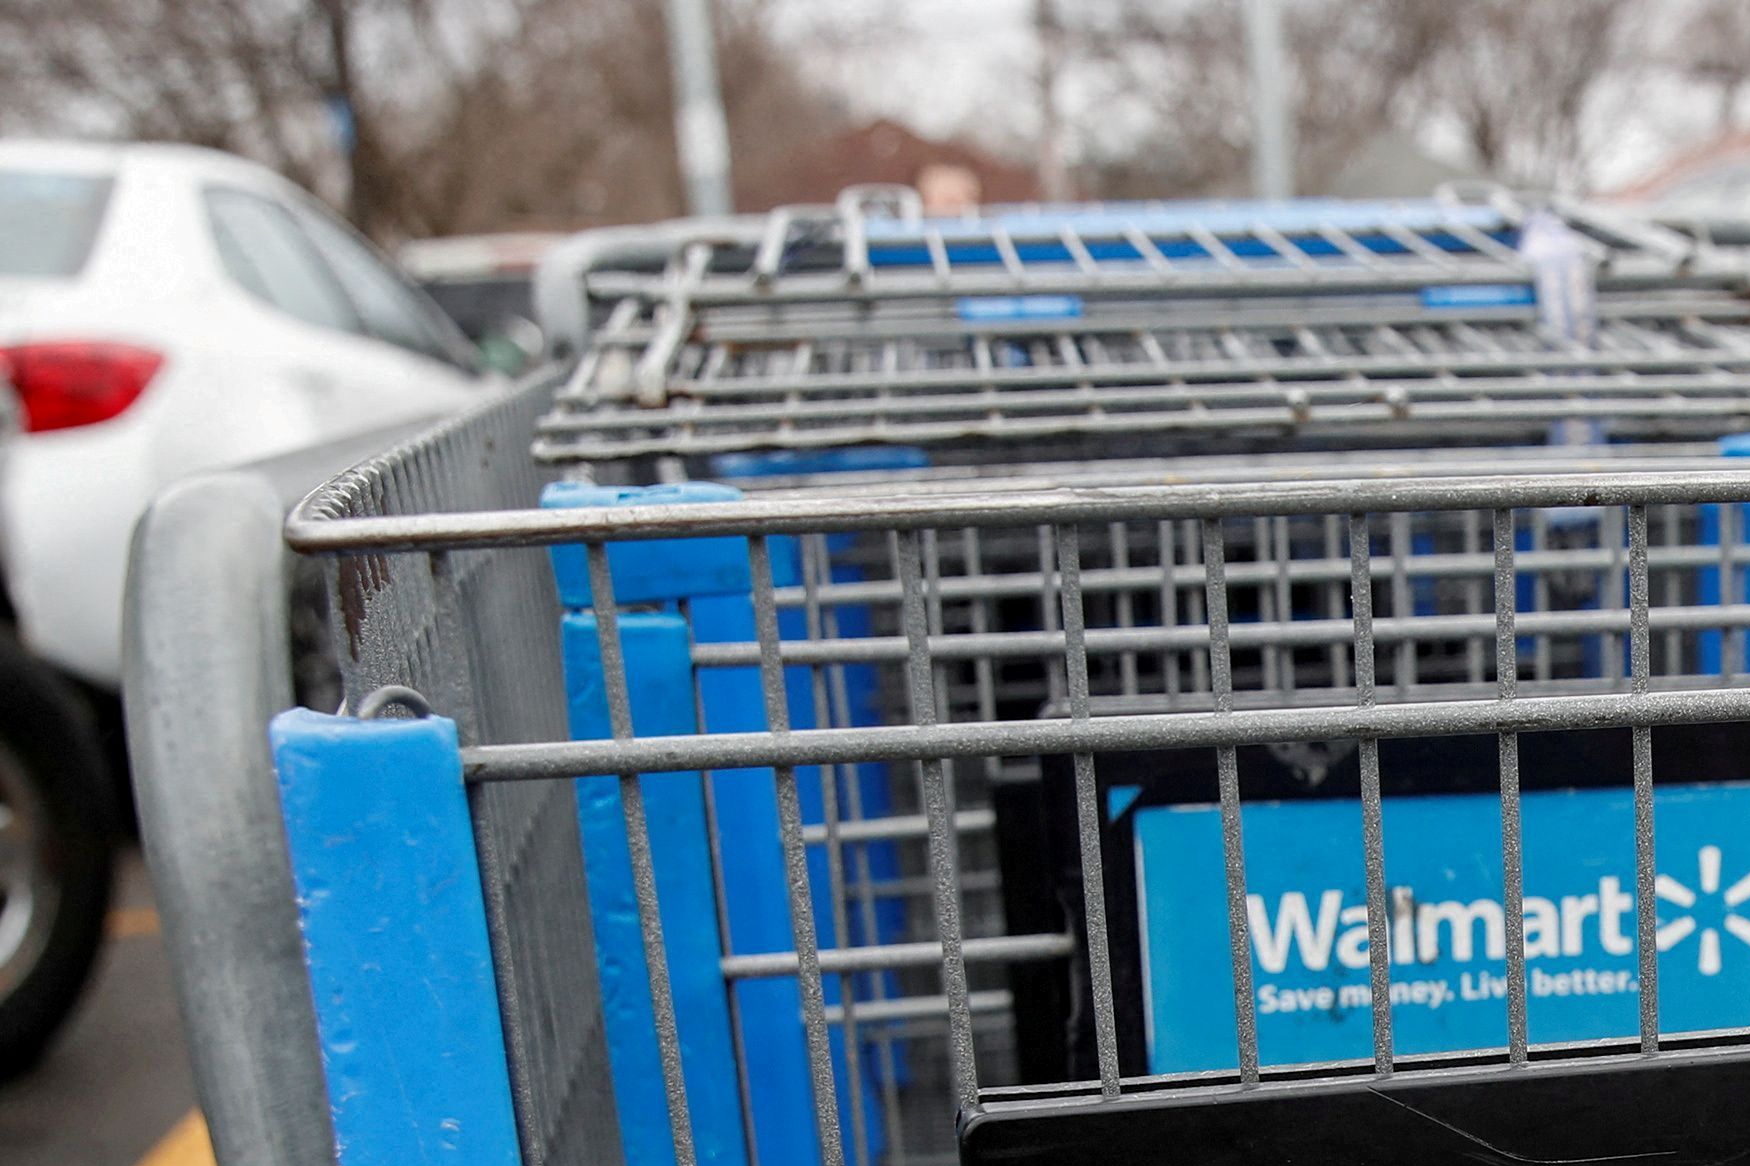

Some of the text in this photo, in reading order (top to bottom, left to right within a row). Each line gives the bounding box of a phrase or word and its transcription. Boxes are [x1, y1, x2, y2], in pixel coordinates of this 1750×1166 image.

[1243, 875, 1634, 974] Walmart
[1257, 967, 1640, 1014] Save mney. Liv better.
